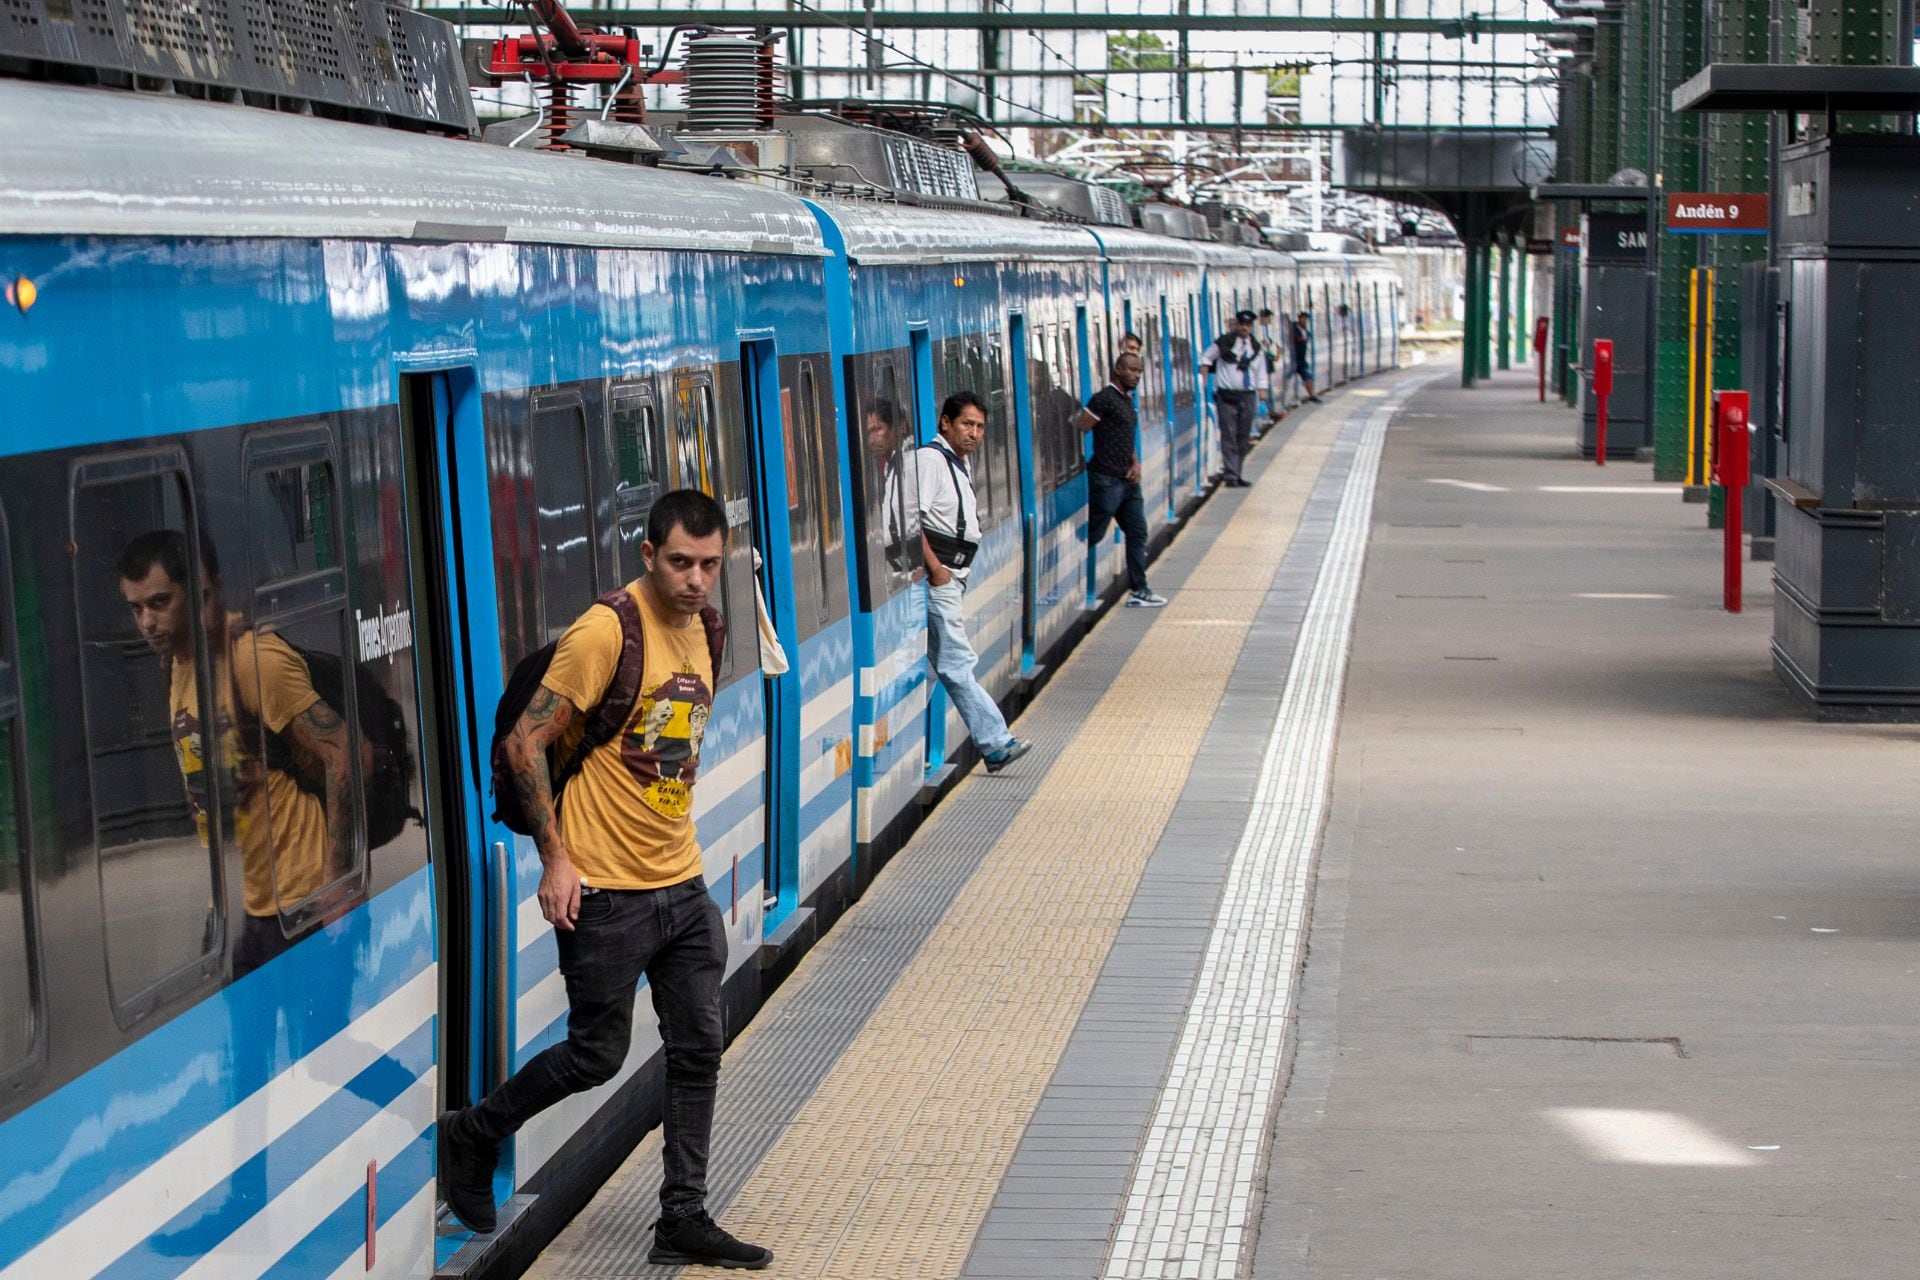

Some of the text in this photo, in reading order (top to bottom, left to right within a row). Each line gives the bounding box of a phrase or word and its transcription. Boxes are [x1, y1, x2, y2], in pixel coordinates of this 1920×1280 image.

[1674, 203, 1740, 220] Andén 9
[355, 608, 382, 663] Trenes
